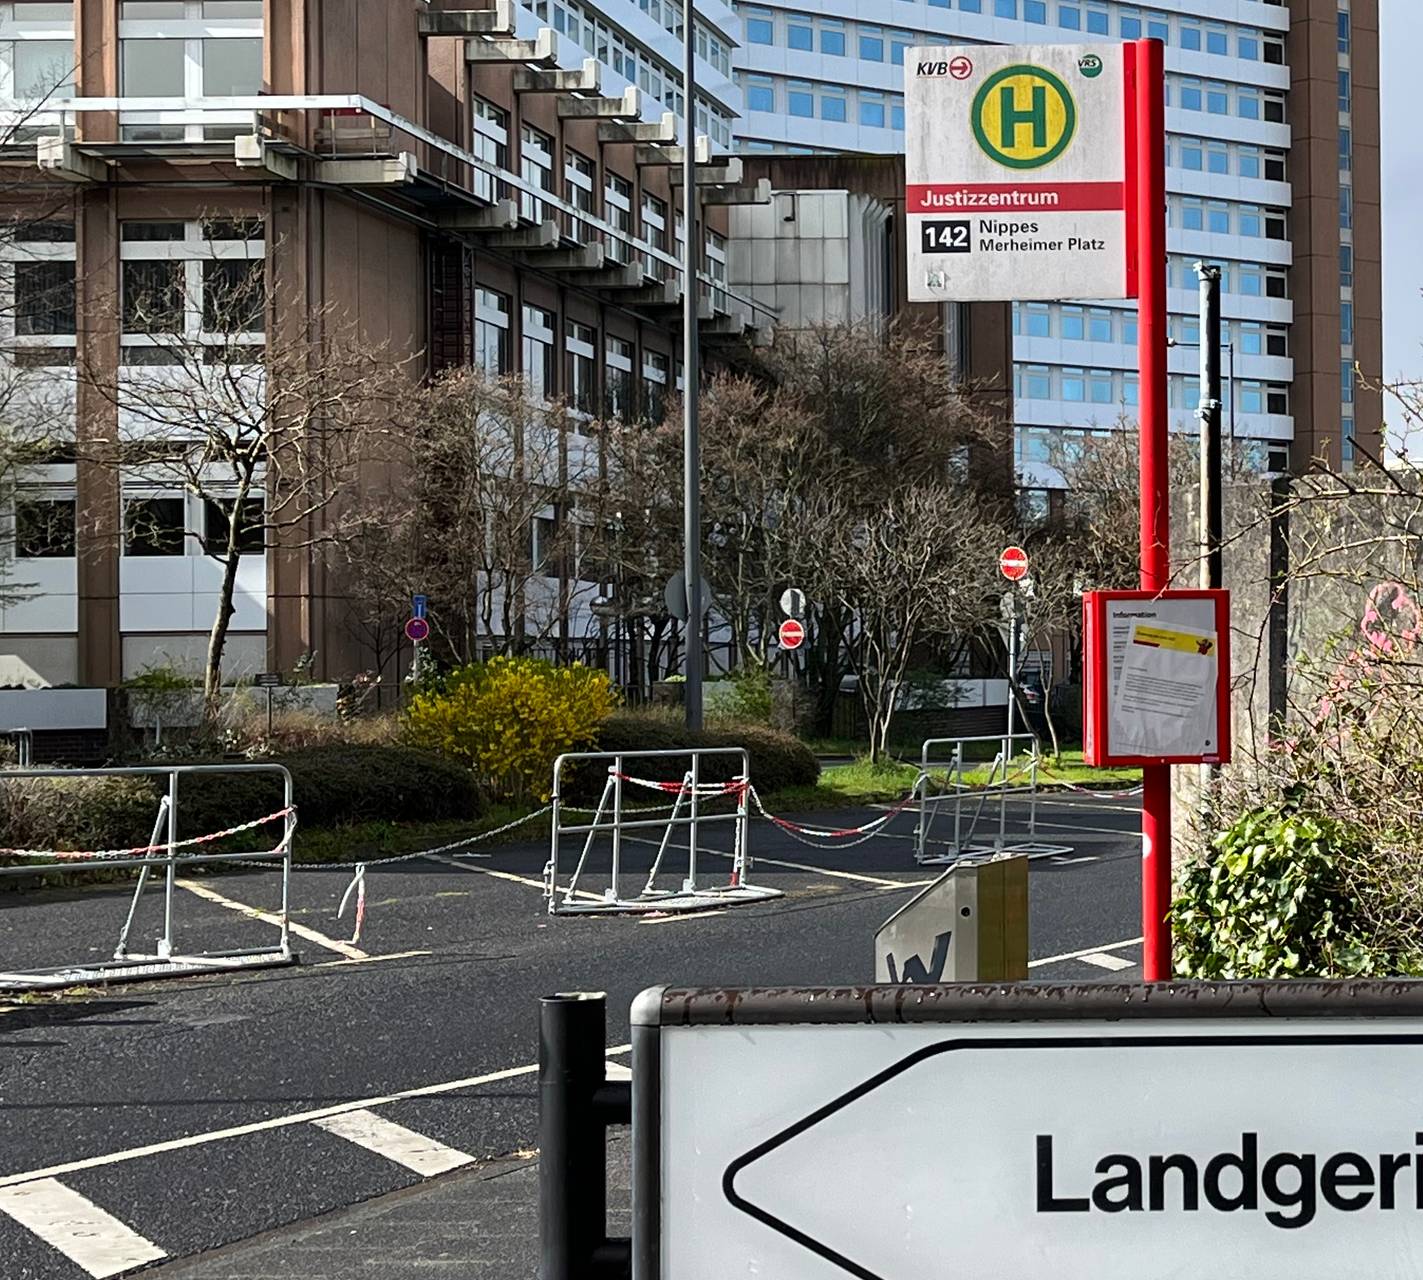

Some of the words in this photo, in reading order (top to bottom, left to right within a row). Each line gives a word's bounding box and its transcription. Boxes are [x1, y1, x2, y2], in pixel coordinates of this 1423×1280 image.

[916, 62, 948, 76] KVB
[1077, 59, 1097, 68] VRS
[1001, 86, 1047, 148] H
[920, 190, 1059, 207] Justizzentrum
[979, 219, 1039, 234] Nippes
[925, 226, 968, 247] 142
[979, 237, 1064, 252] Merheimer
[1068, 237, 1105, 250] Platz
[1113, 611, 1157, 619] Information
